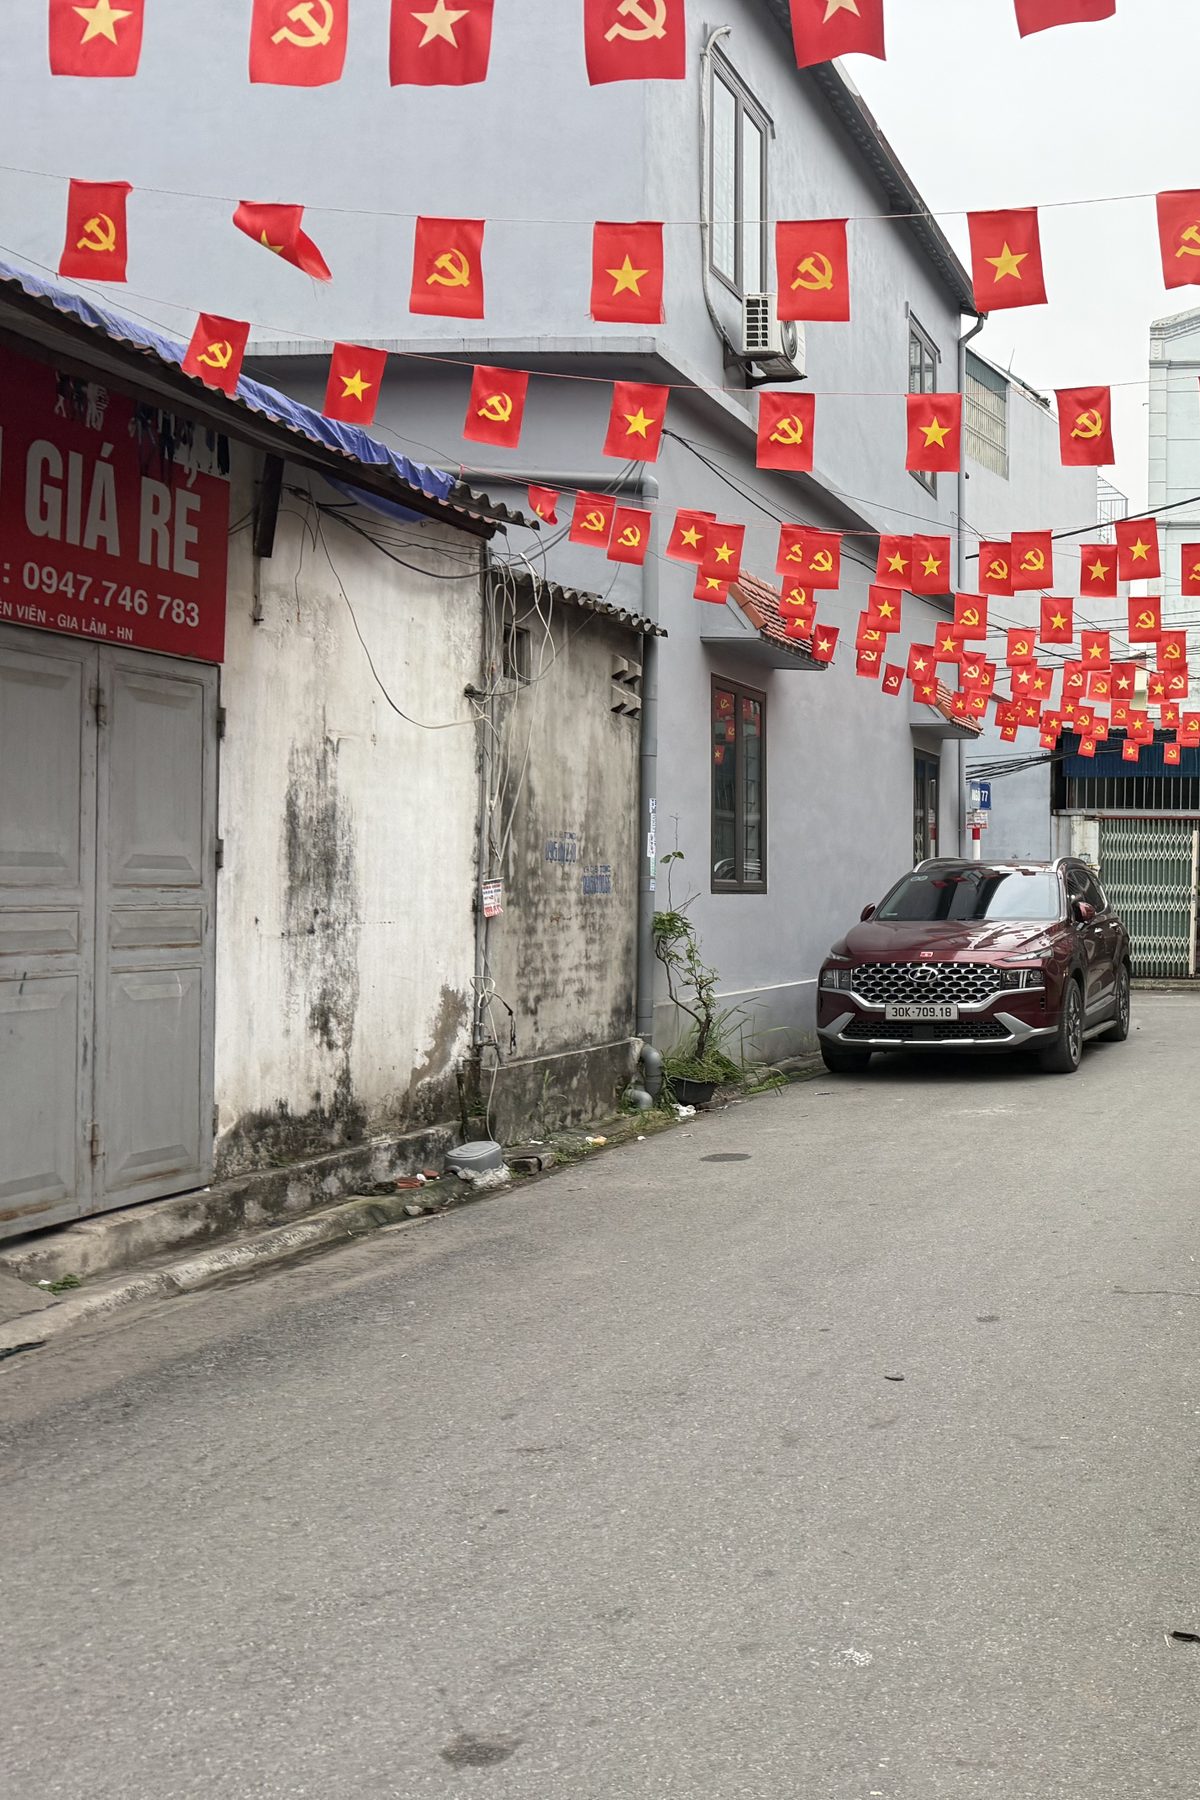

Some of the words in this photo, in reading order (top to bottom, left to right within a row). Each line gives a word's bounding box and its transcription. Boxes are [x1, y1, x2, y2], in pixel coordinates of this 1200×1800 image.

[25, 439, 120, 557] GIÁ
[23, 561, 148, 616] 0947.746
[157, 594, 200, 628] 783
[16, 604, 46, 624] VIÊN
[57, 613, 79, 630] GIA
[82, 617, 107, 636] LÂM
[117, 627, 133, 641] HN
[981, 790, 988, 802] 77
[892, 1007, 951, 1017] 30K-709.18
